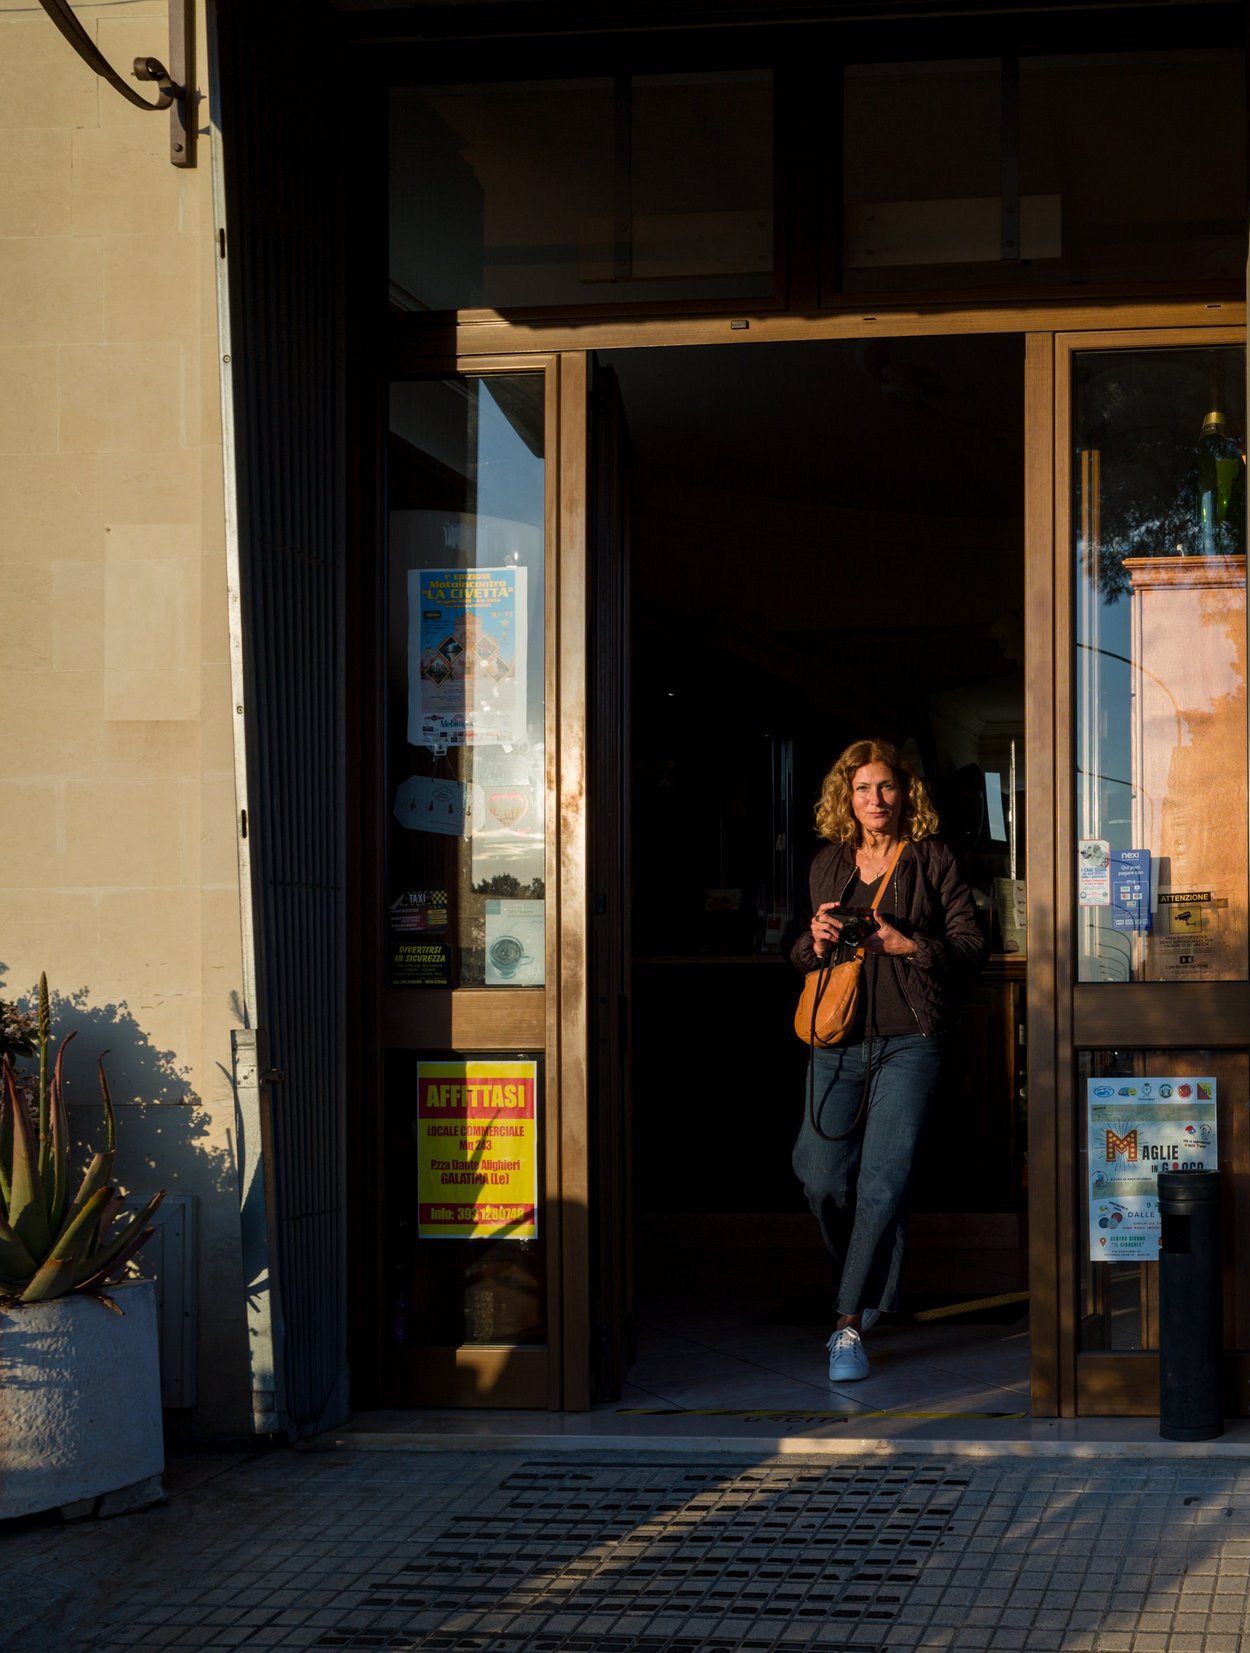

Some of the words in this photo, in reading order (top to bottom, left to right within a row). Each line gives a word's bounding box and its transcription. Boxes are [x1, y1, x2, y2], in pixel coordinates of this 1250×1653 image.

[409, 893, 426, 903] TAXI
[1160, 893, 1209, 902] ATTENZIONE
[399, 945, 442, 954] DIVERTIRSI
[394, 954, 404, 963] IN
[405, 954, 446, 963] SICUREZZA
[426, 1085, 525, 1108] AFFITTASI
[427, 1126, 458, 1136] LOCALE
[460, 1126, 525, 1136] COMMERCIALE
[459, 1140, 474, 1151] Mq
[475, 1140, 492, 1151] 243
[431, 1160, 450, 1171] Pzza
[452, 1160, 479, 1171] Dante
[481, 1160, 520, 1171] Alighieri
[1151, 1164, 1158, 1173] IN
[441, 1173, 488, 1185] GALATINA
[490, 1173, 510, 1185] (Le)
[431, 1208, 455, 1220] Info:
[457, 1208, 479, 1220] 393
